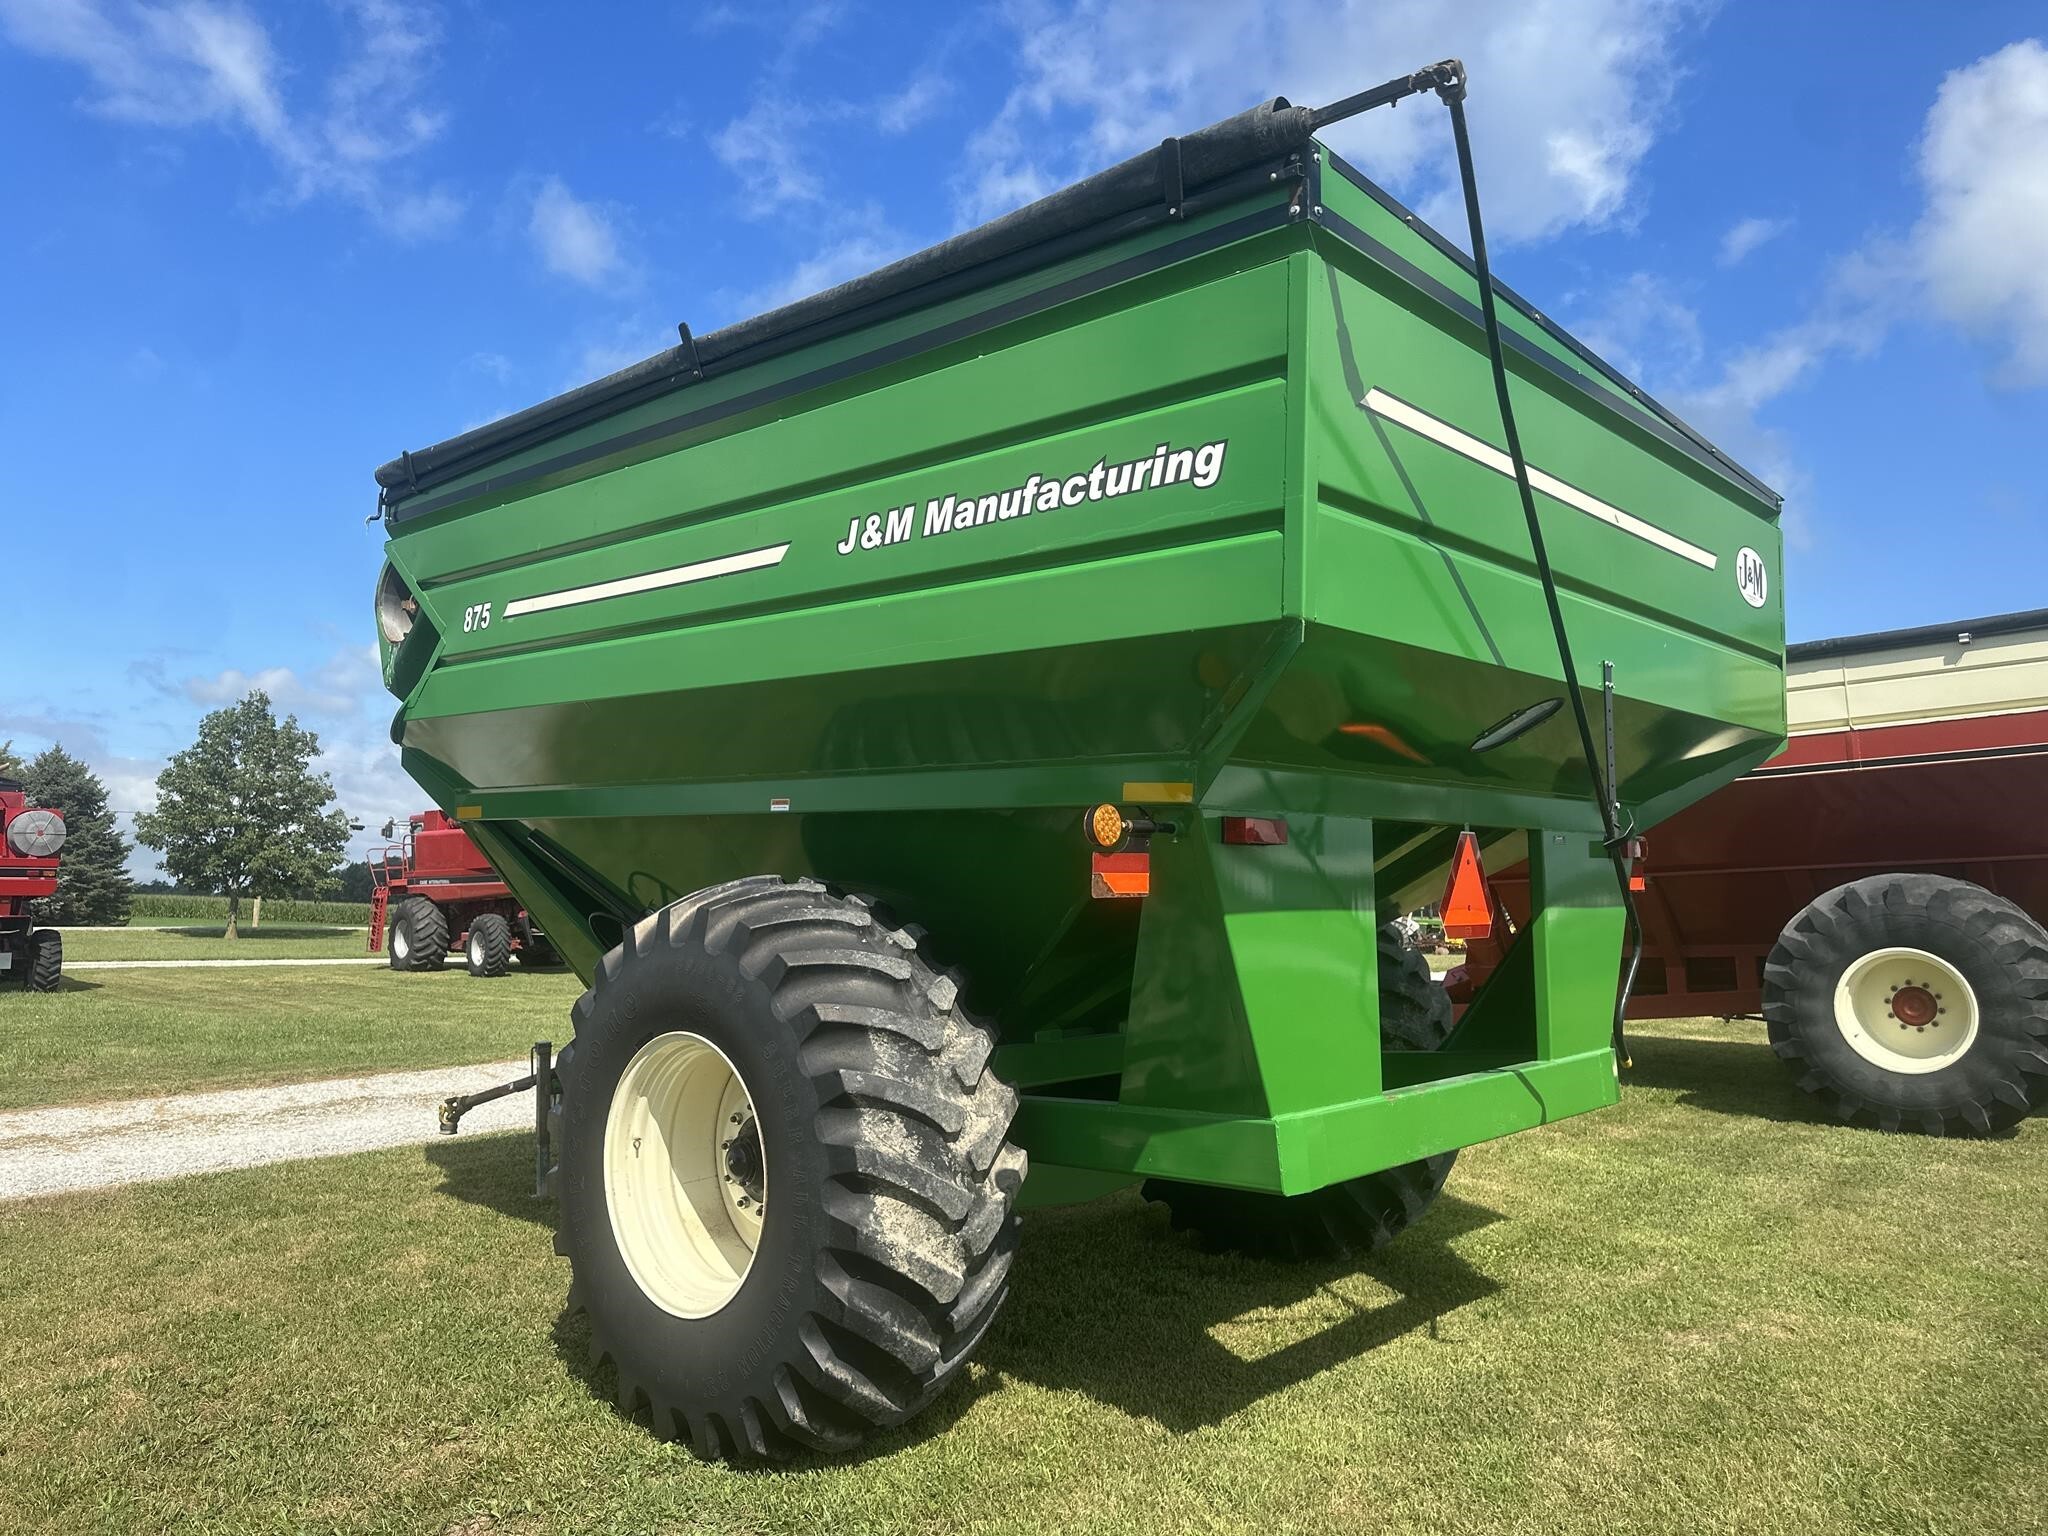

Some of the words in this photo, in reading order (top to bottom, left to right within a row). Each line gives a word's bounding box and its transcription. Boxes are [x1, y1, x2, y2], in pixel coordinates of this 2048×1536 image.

[837, 504, 916, 555] J&M
[921, 439, 1229, 538] Manufacturing
[1739, 553, 1763, 599] J&M
[463, 601, 492, 633] 875
